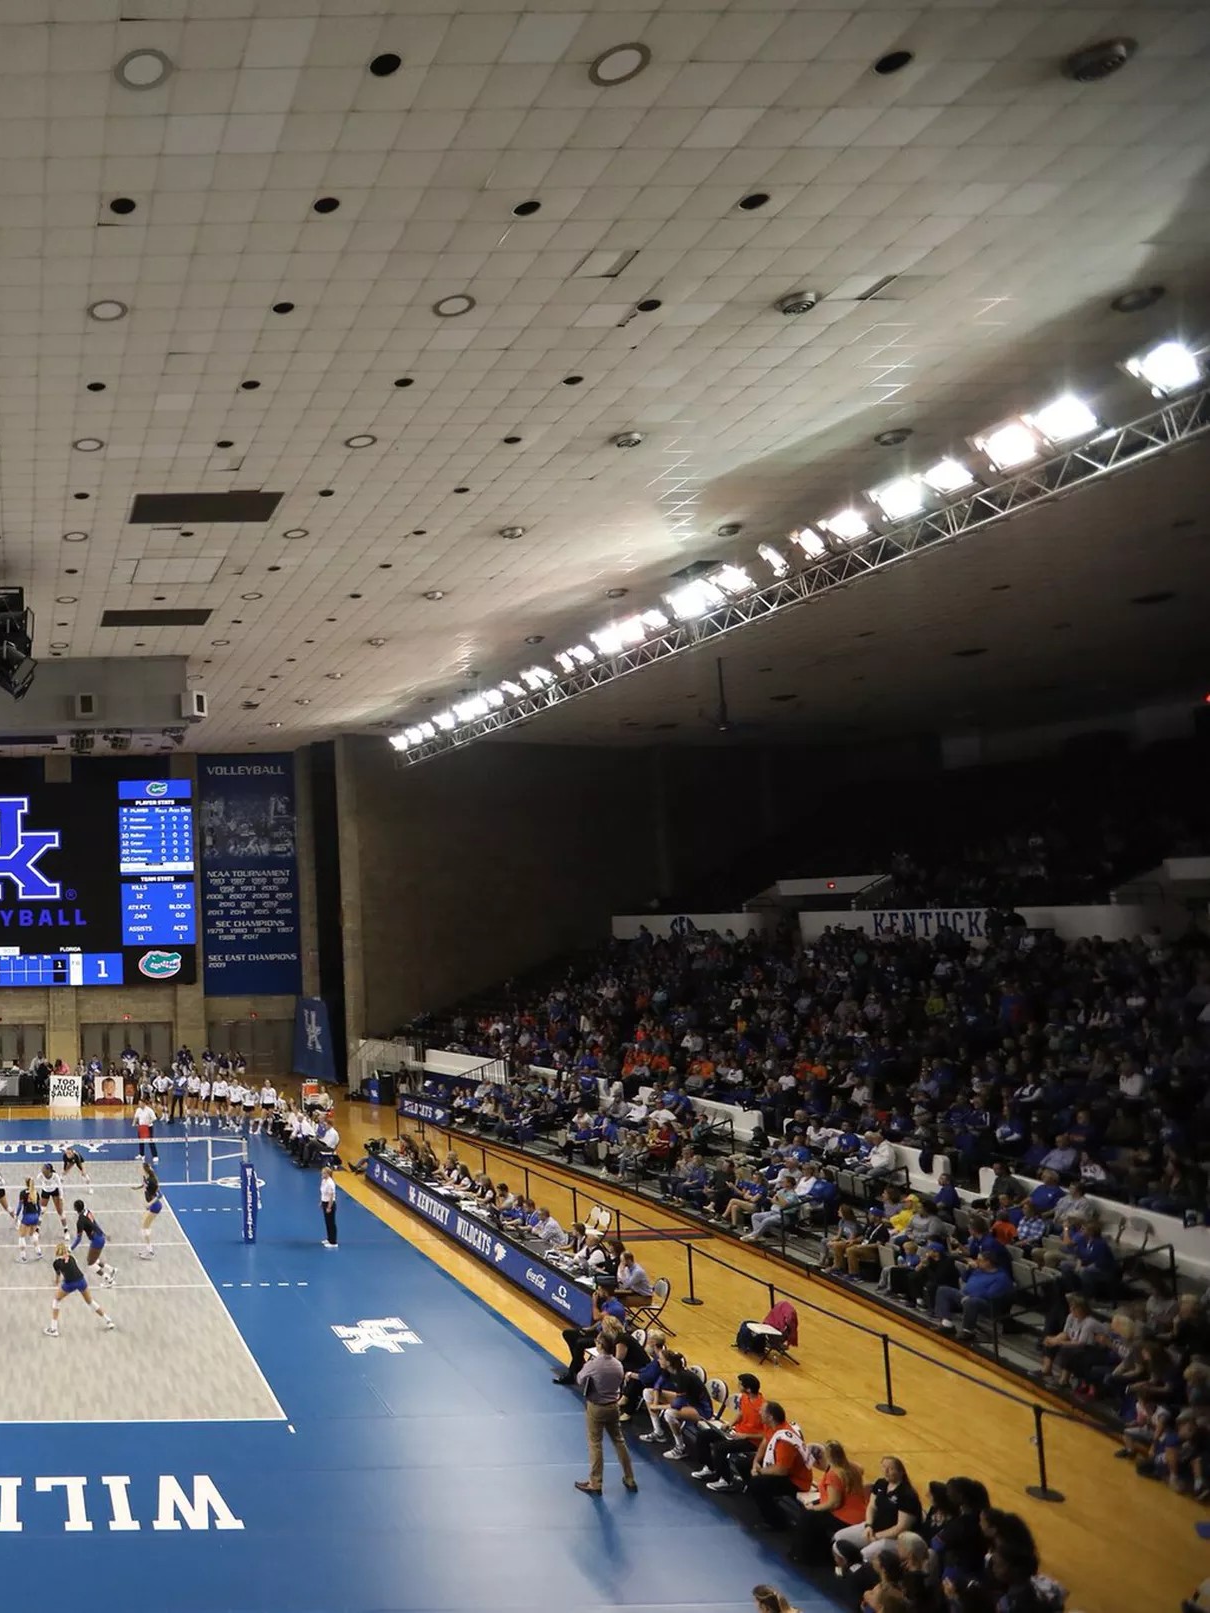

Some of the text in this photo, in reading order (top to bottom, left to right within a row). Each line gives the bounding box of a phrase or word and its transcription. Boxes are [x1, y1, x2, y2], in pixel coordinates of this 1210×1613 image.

[206, 766, 285, 775] VOLLEYBALL
[873, 912, 989, 936] KENTUCK
[97, 960, 108, 978] 1
[417, 1191, 450, 1226] KENTUCKY
[456, 1216, 492, 1256] WILDCATS
